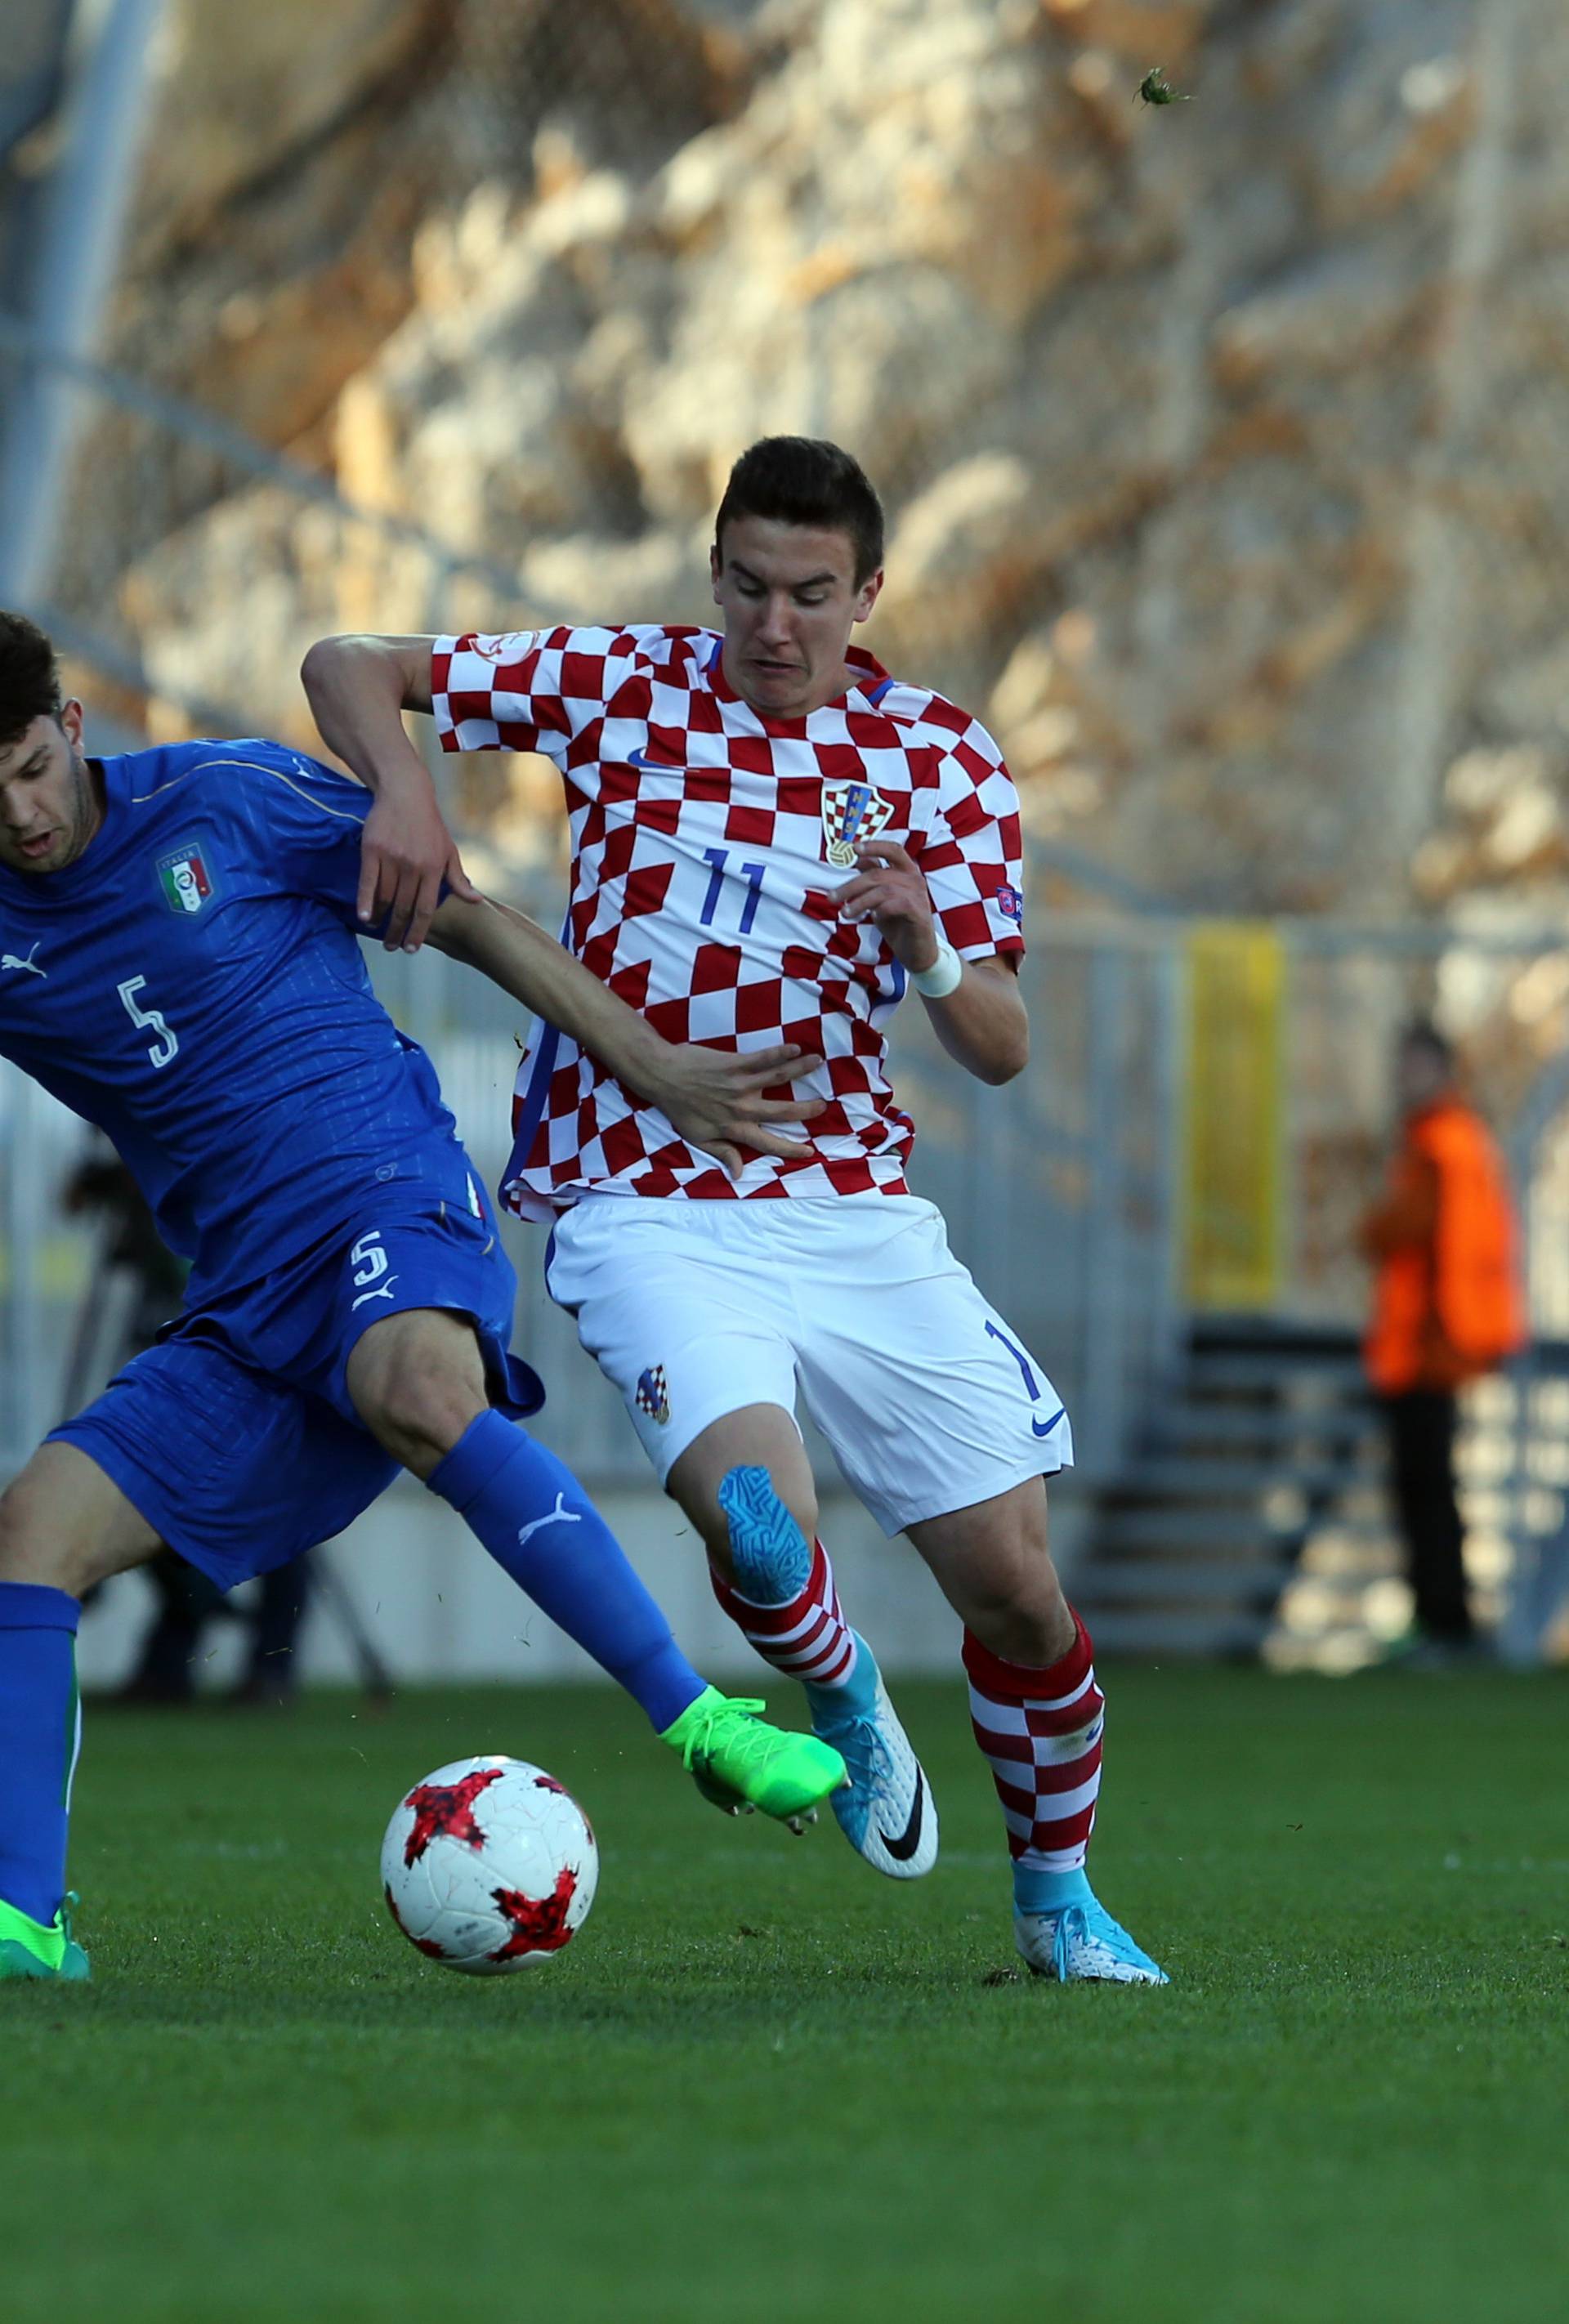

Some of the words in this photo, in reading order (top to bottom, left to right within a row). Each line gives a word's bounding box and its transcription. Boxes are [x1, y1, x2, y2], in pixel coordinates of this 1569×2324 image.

[700, 847, 766, 935] 11
[116, 974, 179, 1069] 5
[351, 1231, 389, 1287] 5
